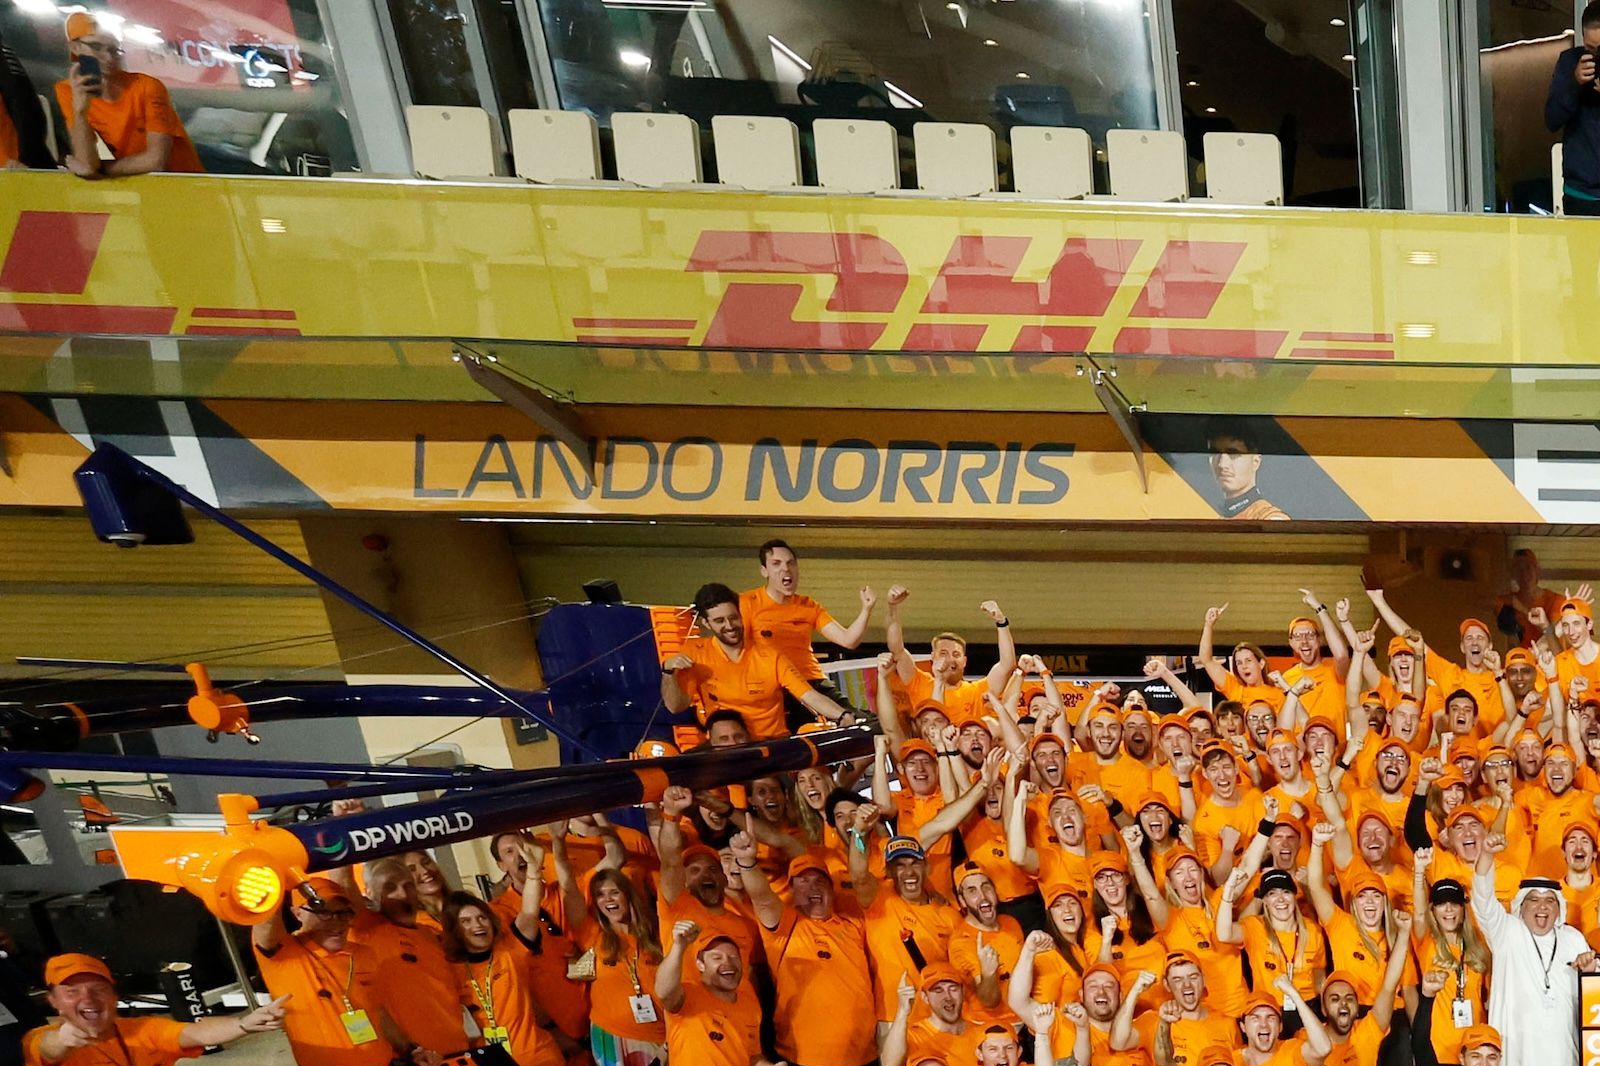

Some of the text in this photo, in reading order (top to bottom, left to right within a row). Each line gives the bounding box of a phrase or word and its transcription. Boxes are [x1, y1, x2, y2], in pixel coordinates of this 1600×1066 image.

[686, 230, 1290, 359] DHL
[414, 434, 1075, 504] LANDO NORRIS
[348, 810, 473, 853] DP WORLD
